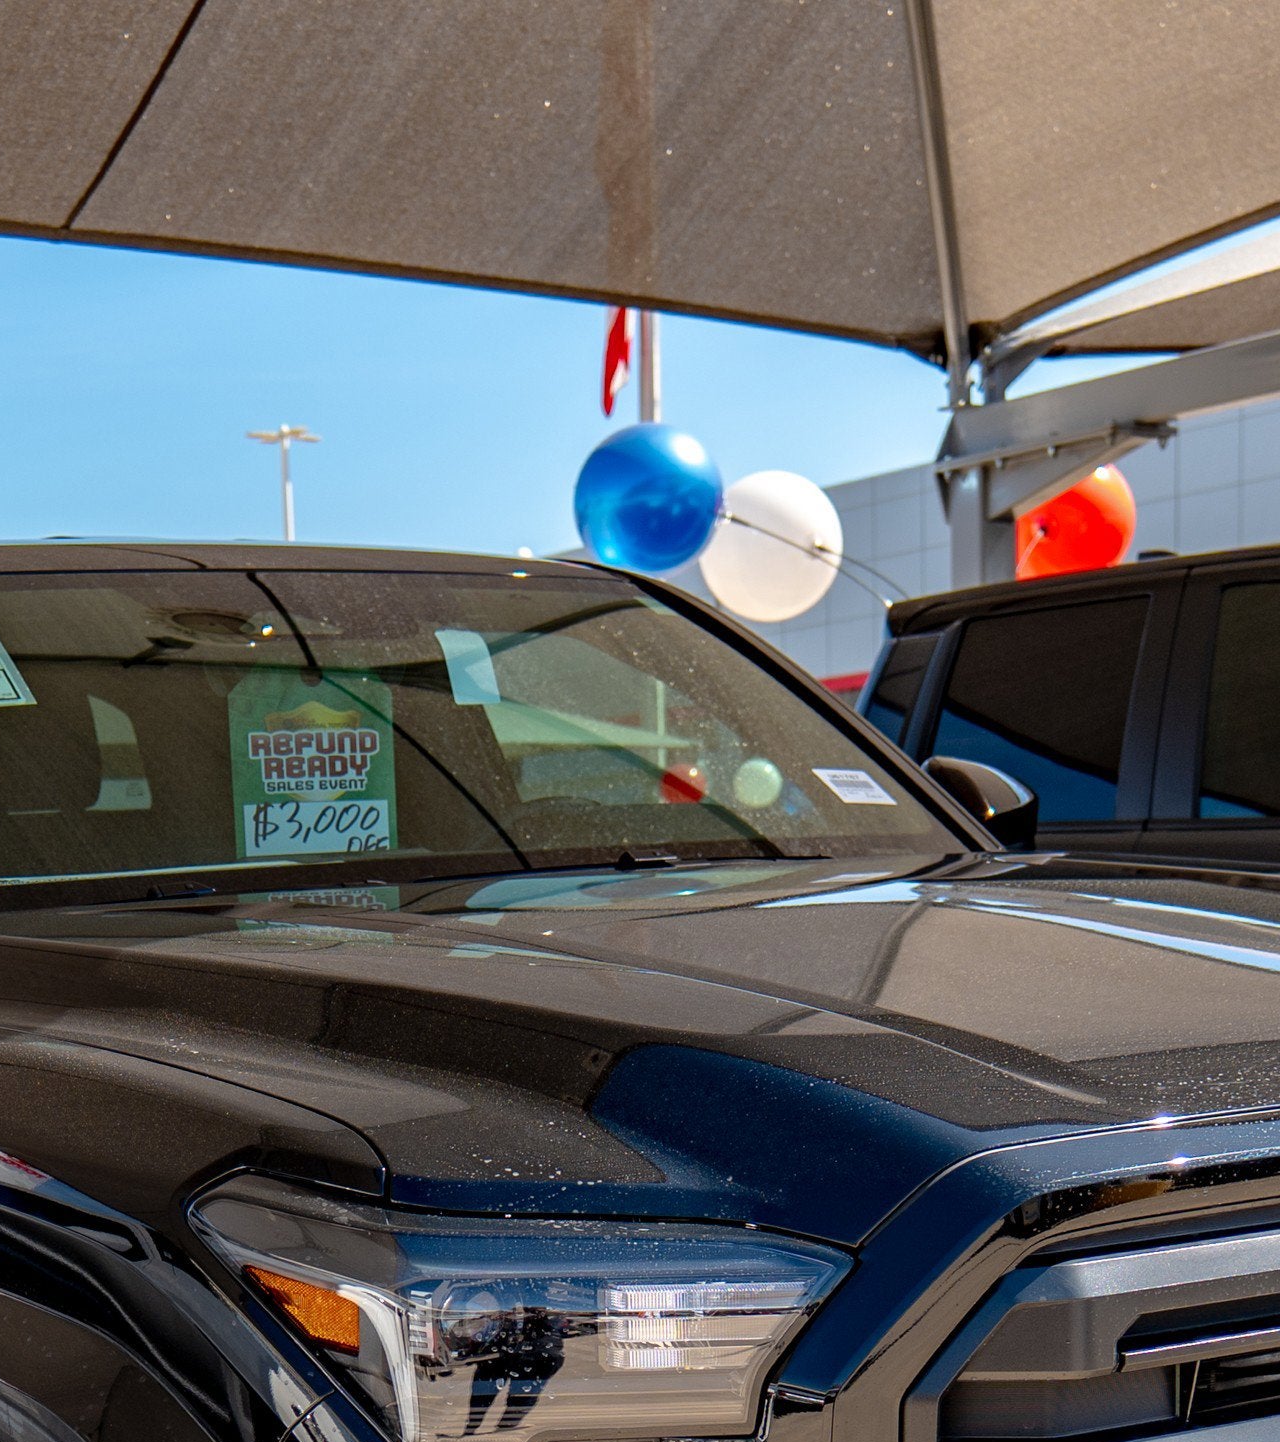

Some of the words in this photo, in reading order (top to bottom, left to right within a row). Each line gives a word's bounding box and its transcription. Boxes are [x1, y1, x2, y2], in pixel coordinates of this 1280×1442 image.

[249, 730, 379, 758] REFUND
[263, 755, 369, 779] READY
[267, 779, 314, 792] SALES
[319, 778, 366, 790] EVENT
[253, 801, 380, 848] $3,000
